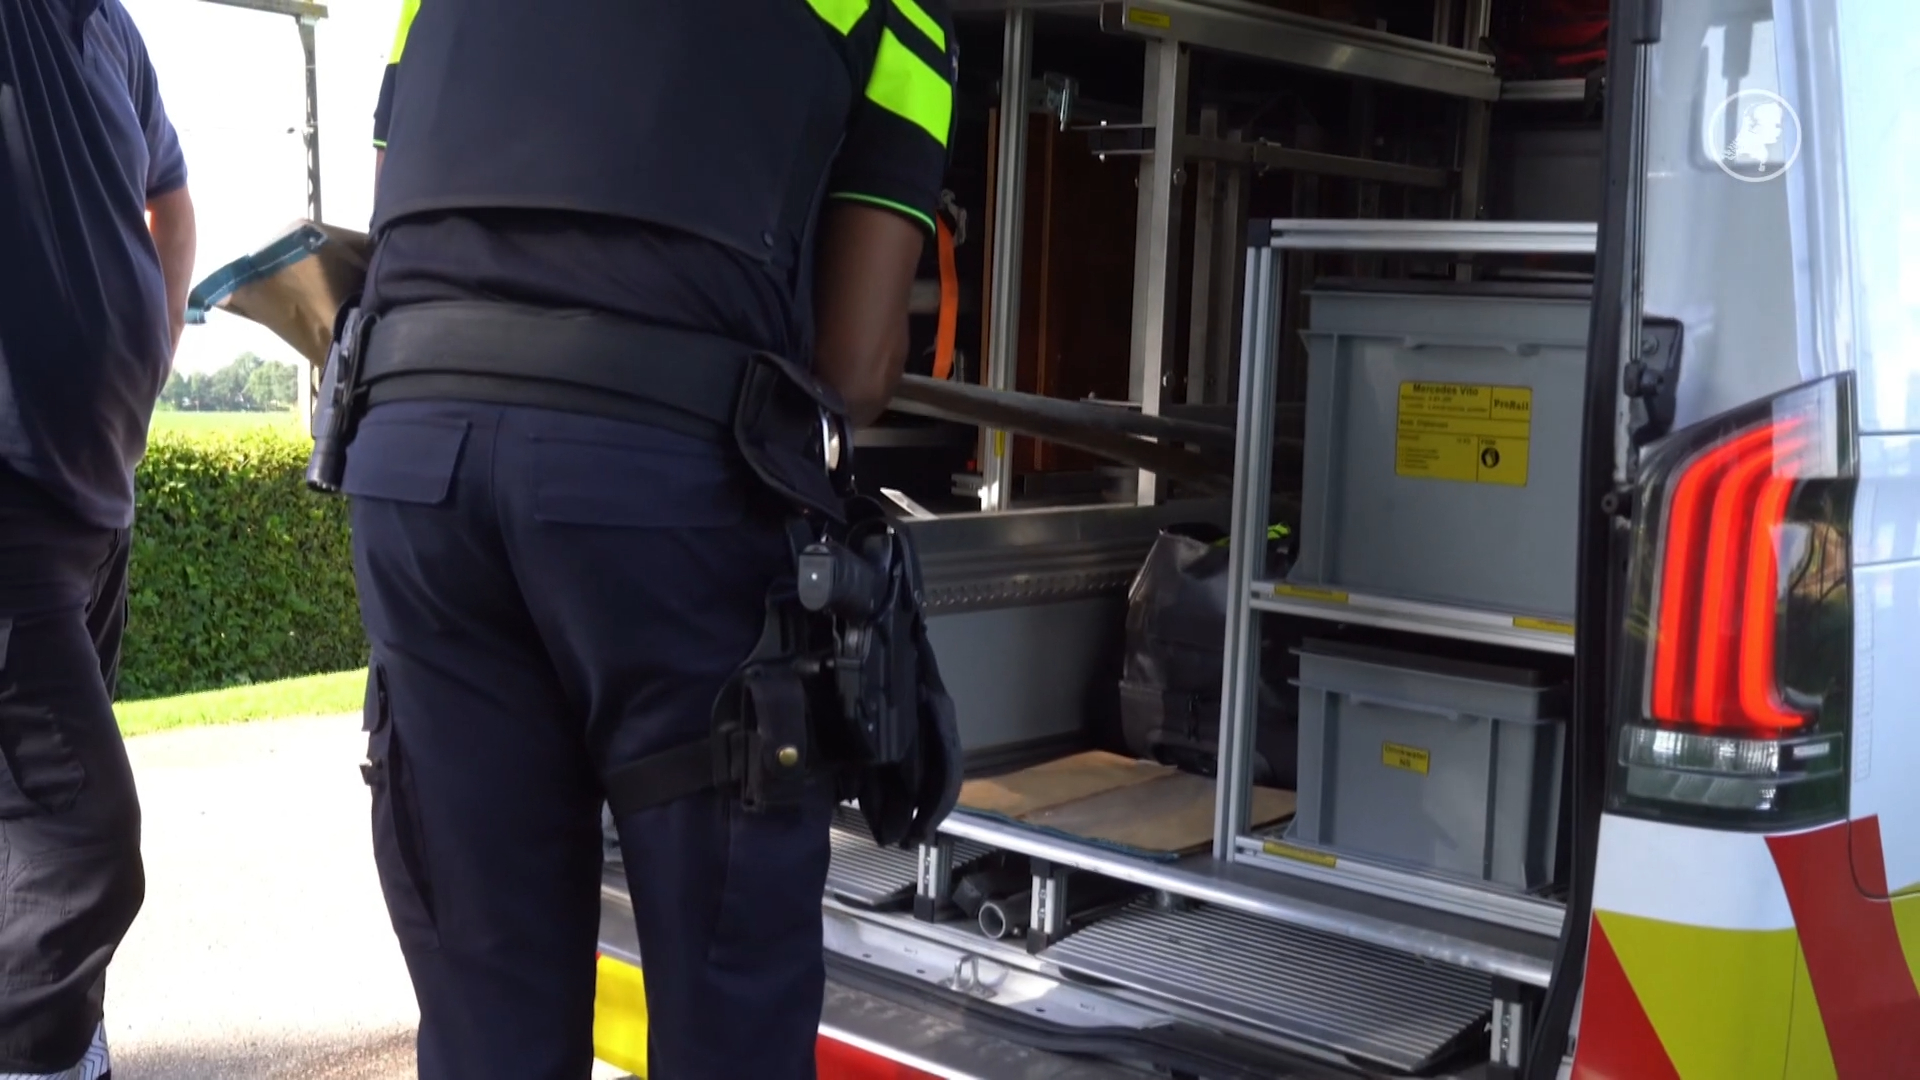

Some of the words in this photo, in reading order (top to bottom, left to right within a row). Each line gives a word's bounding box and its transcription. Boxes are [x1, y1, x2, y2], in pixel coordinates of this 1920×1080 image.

[1412, 383, 1457, 395] Mercedes
[1460, 386, 1479, 396] Vito
[1494, 399, 1529, 411] ProRail
